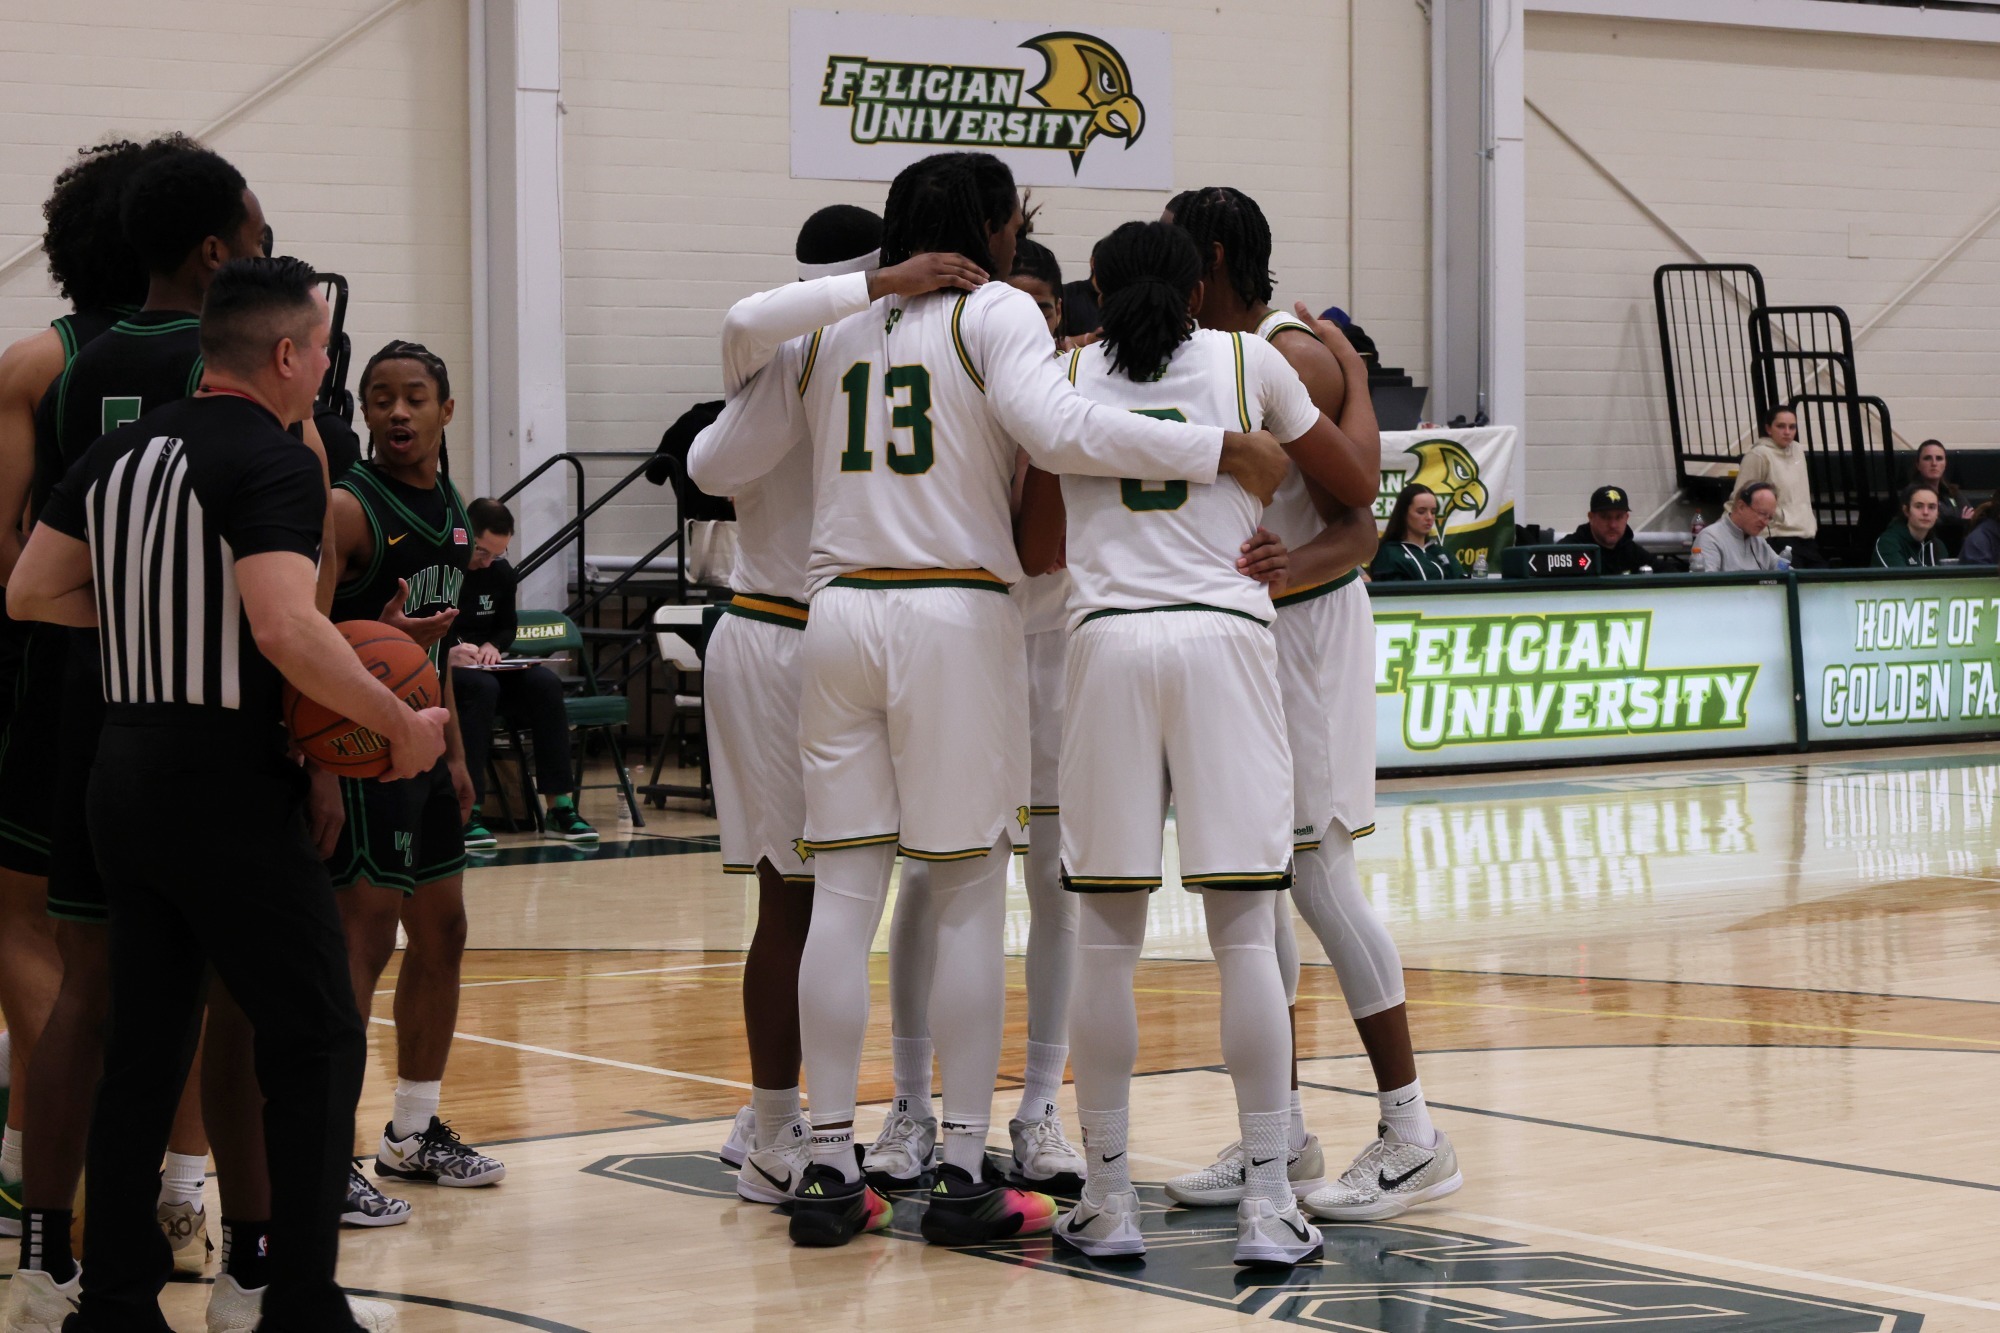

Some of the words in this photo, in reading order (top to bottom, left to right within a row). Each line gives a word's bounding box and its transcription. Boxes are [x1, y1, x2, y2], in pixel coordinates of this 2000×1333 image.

[826, 59, 1021, 106] FELICIAN
[854, 100, 1092, 148] UNIVERSITY
[841, 360, 935, 476] 13
[1375, 617, 1647, 687] FELICIAN
[1855, 598, 1940, 651] HOME
[1946, 596, 1985, 648] OF
[1406, 671, 1752, 747] UNIVERSITY
[1822, 660, 1952, 728] GOLDEN
[1960, 657, 2000, 720] FA
